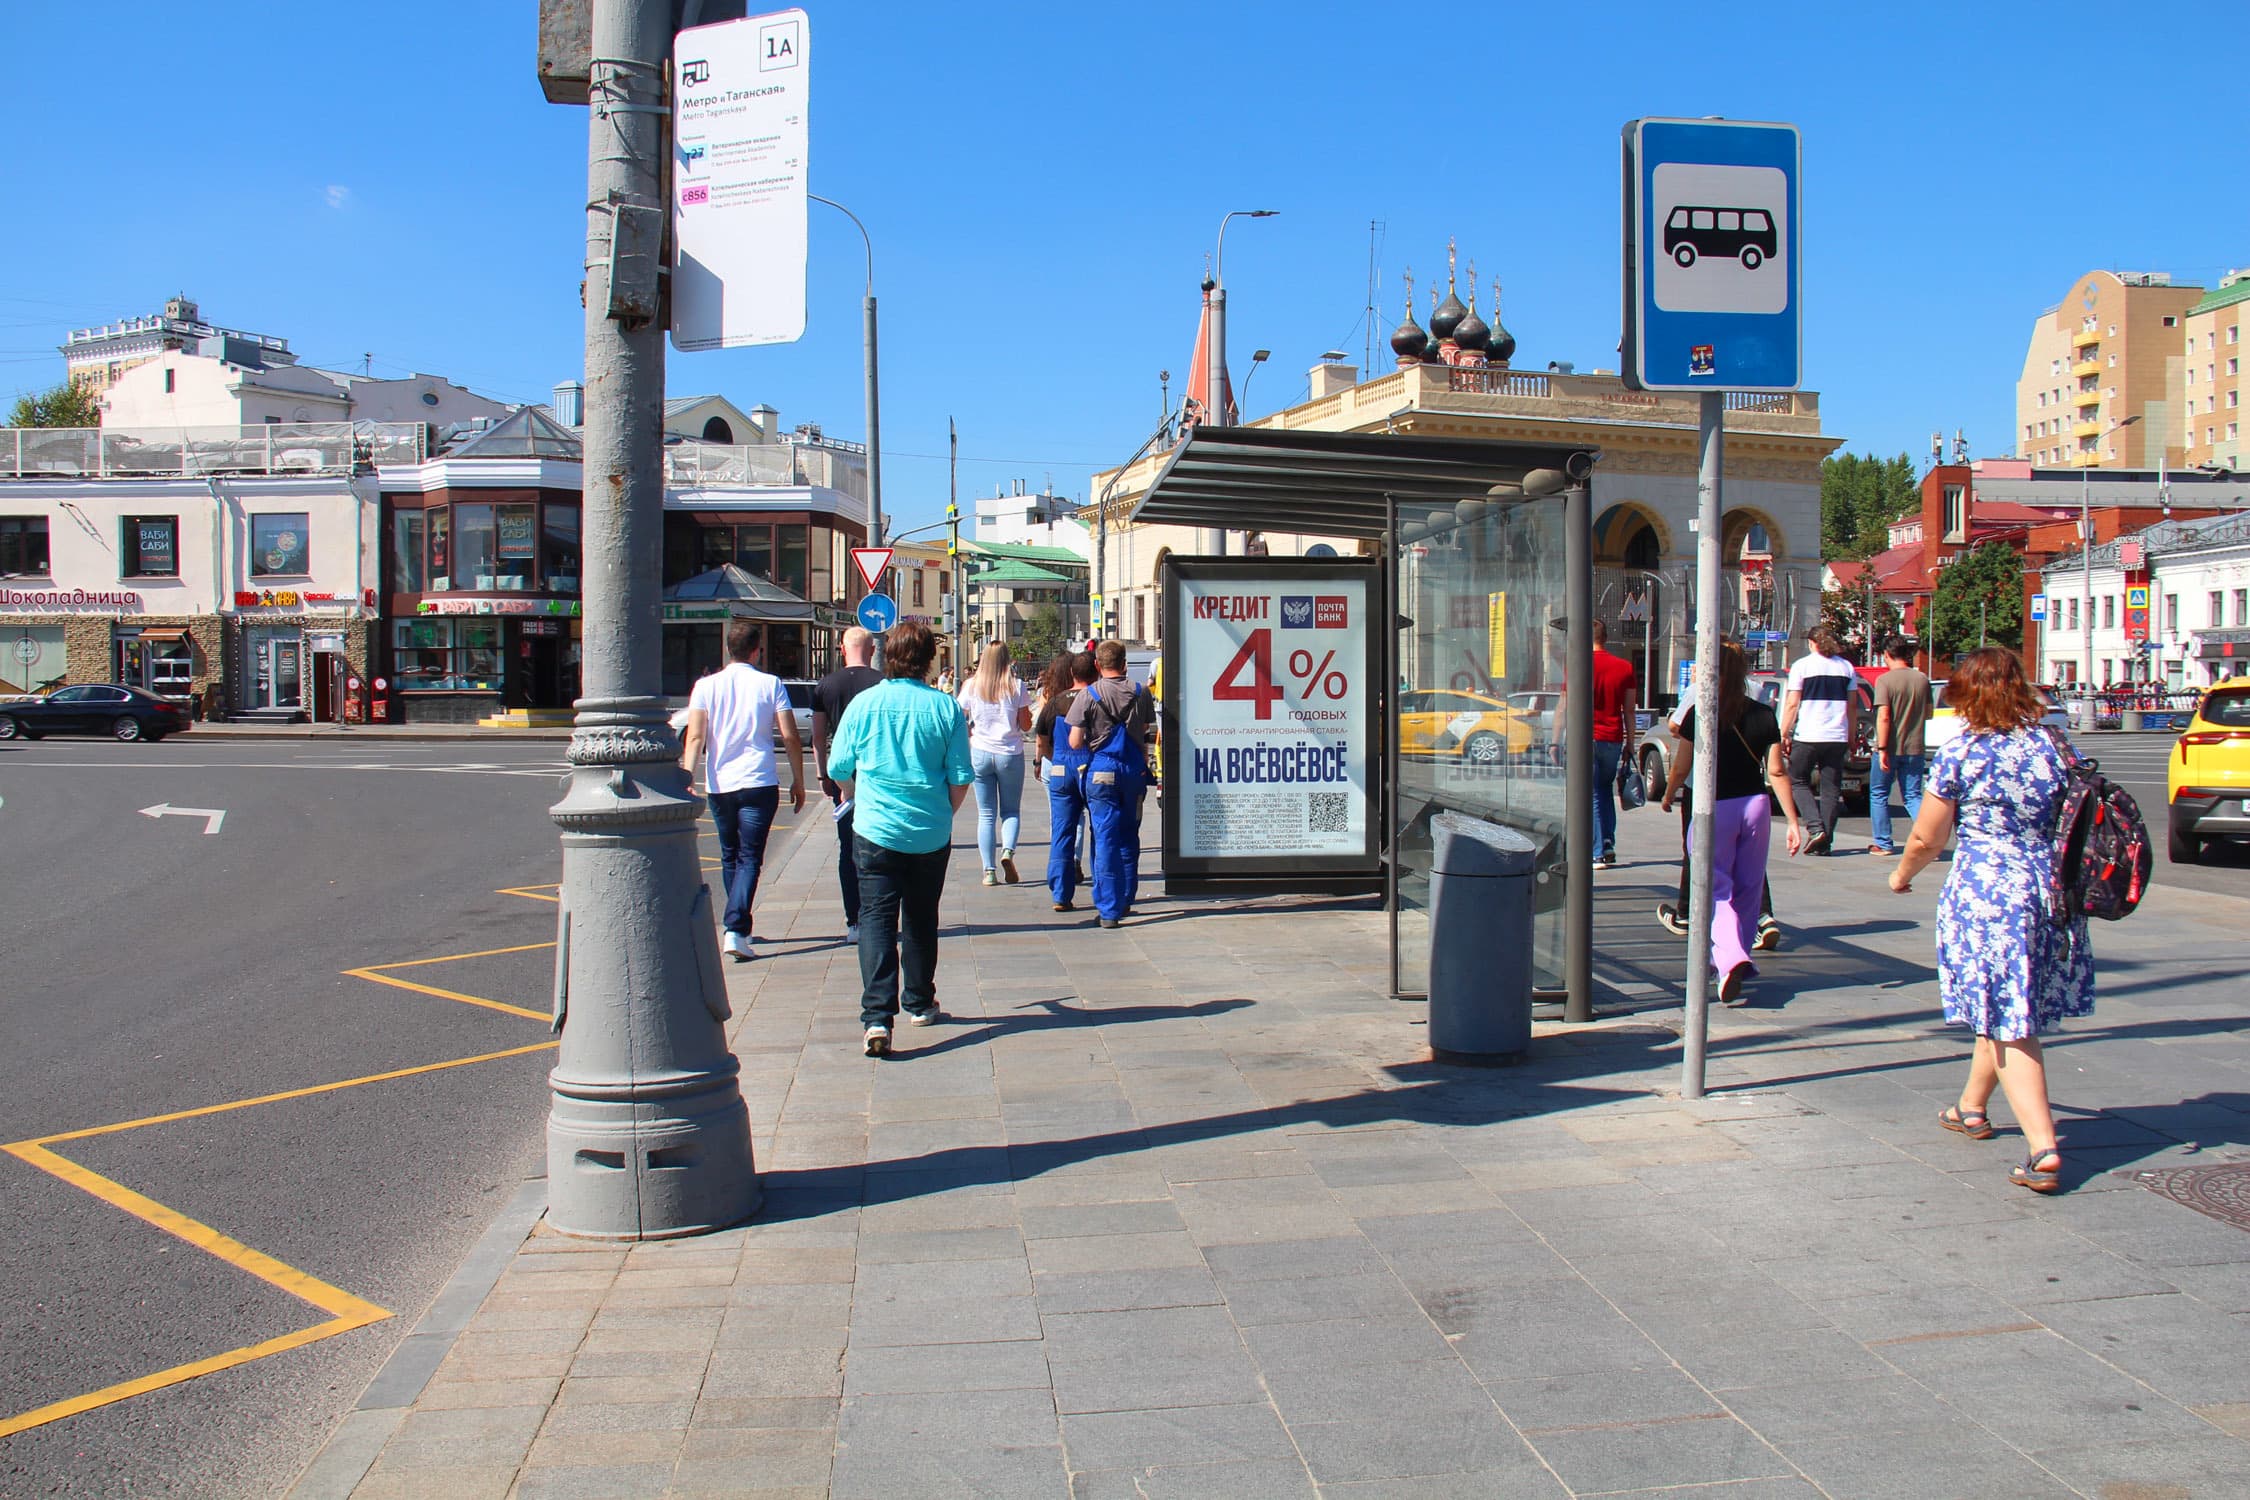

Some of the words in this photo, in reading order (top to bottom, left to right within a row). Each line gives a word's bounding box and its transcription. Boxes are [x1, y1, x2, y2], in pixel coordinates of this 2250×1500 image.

[682, 95, 718, 109] Метро
[720, 85, 785, 103] «Таганская»
[682, 110, 705, 120] Metro
[706, 105, 747, 118] Taganskaya
[682, 190, 706, 202] с856
[141, 530, 169, 540] ВАБИ
[141, 541, 169, 550] САБИ
[0, 588, 136, 606] Шоколадница
[1193, 596, 1271, 622] КРЕДИТ
[1318, 603, 1345, 612] ПОЧТА
[1318, 613, 1342, 622] БАНК
[1288, 710, 1347, 721] ГОДОВЫХ
[1201, 727, 1236, 736] УСЛУГОЙ
[1239, 727, 1315, 735] «ГАРАНТИРОВАННАЯ
[1316, 727, 1348, 735] СТАВКА»
[1194, 748, 1223, 784] НА
[1227, 741, 1348, 784] ВСЁВСЁВСЁ
